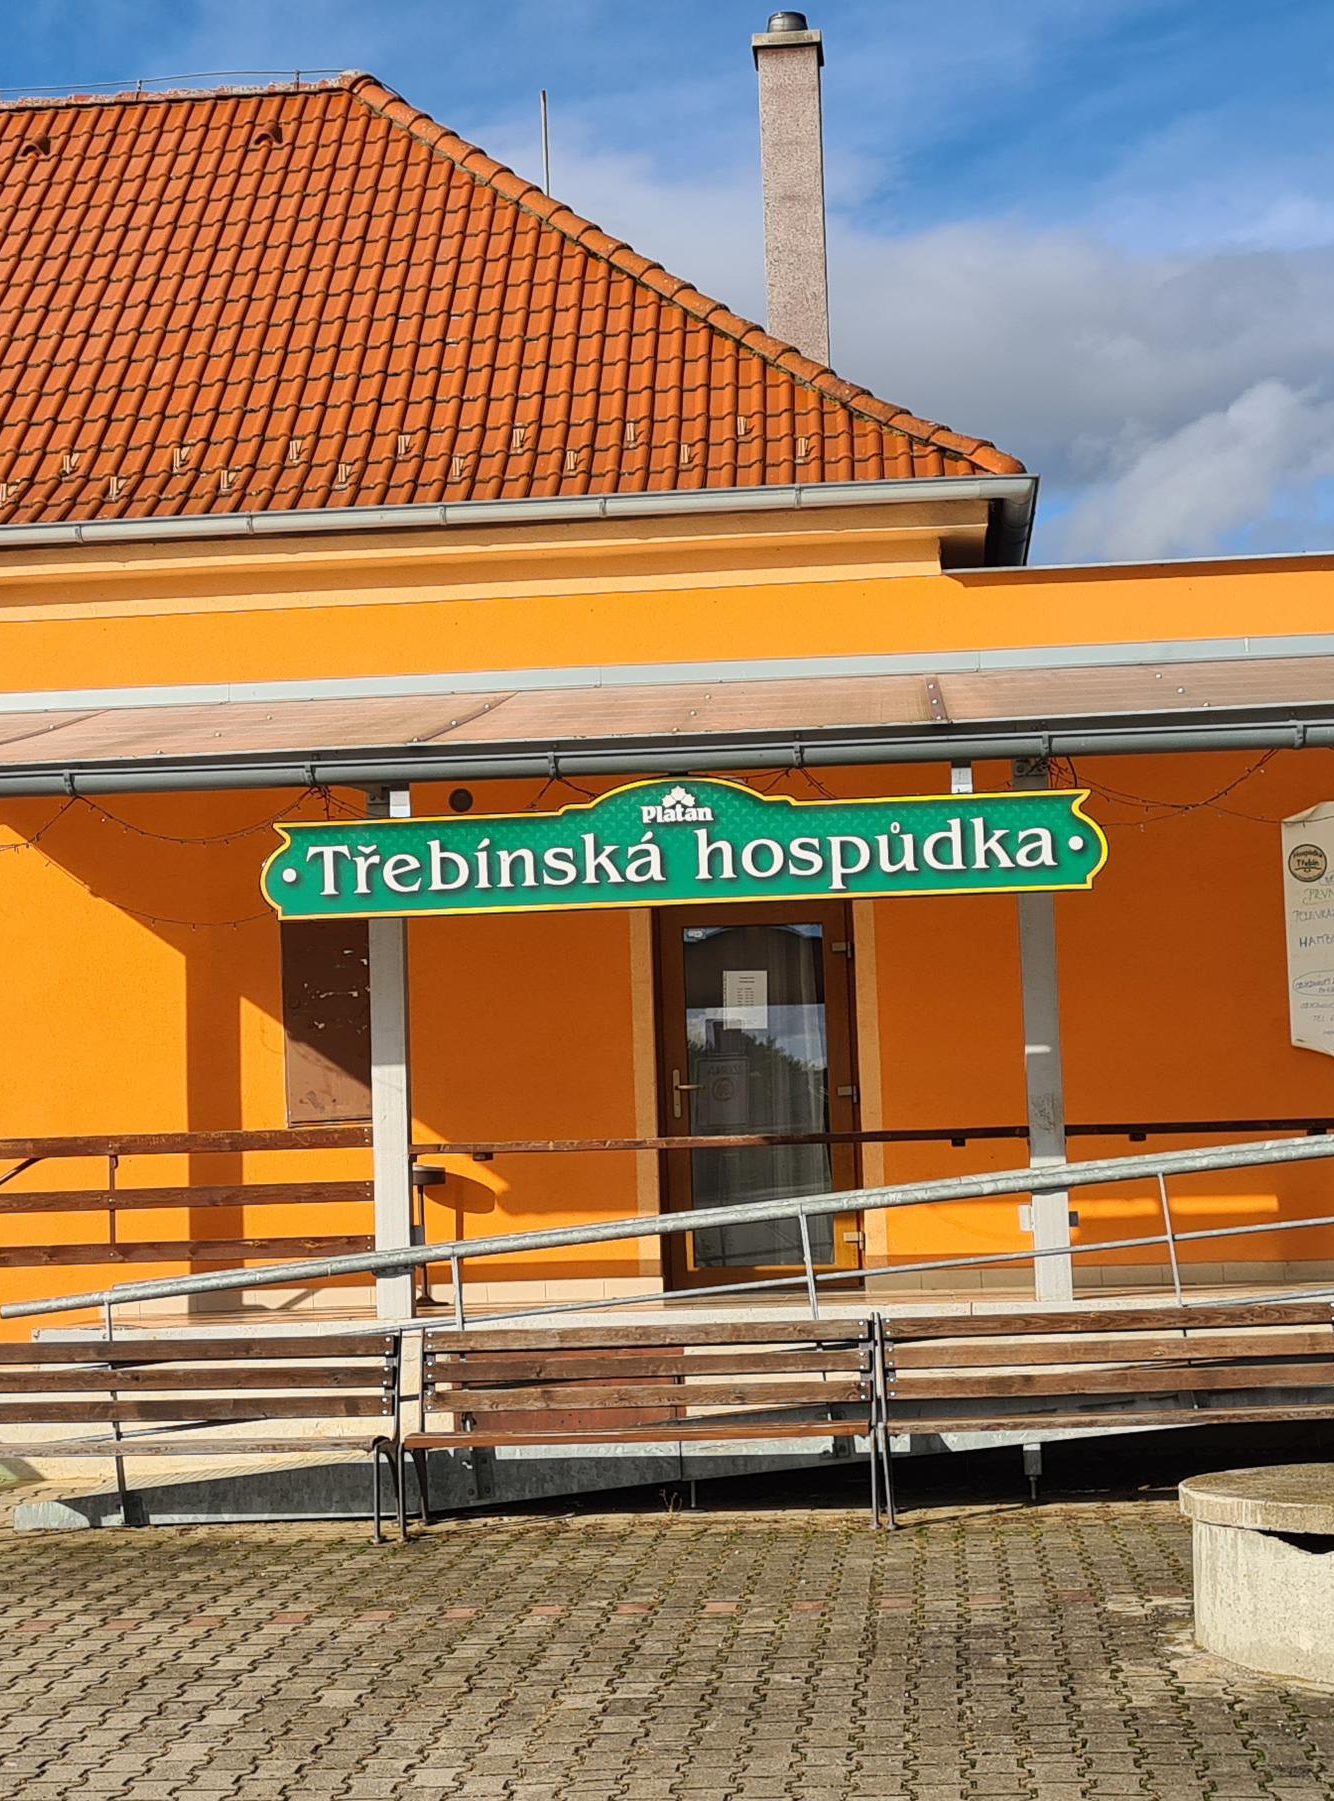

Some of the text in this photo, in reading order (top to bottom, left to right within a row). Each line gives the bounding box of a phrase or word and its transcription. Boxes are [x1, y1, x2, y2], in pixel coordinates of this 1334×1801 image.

[640, 803, 714, 824] Platan
[307, 816, 1059, 897] Třebínská hospůdka
